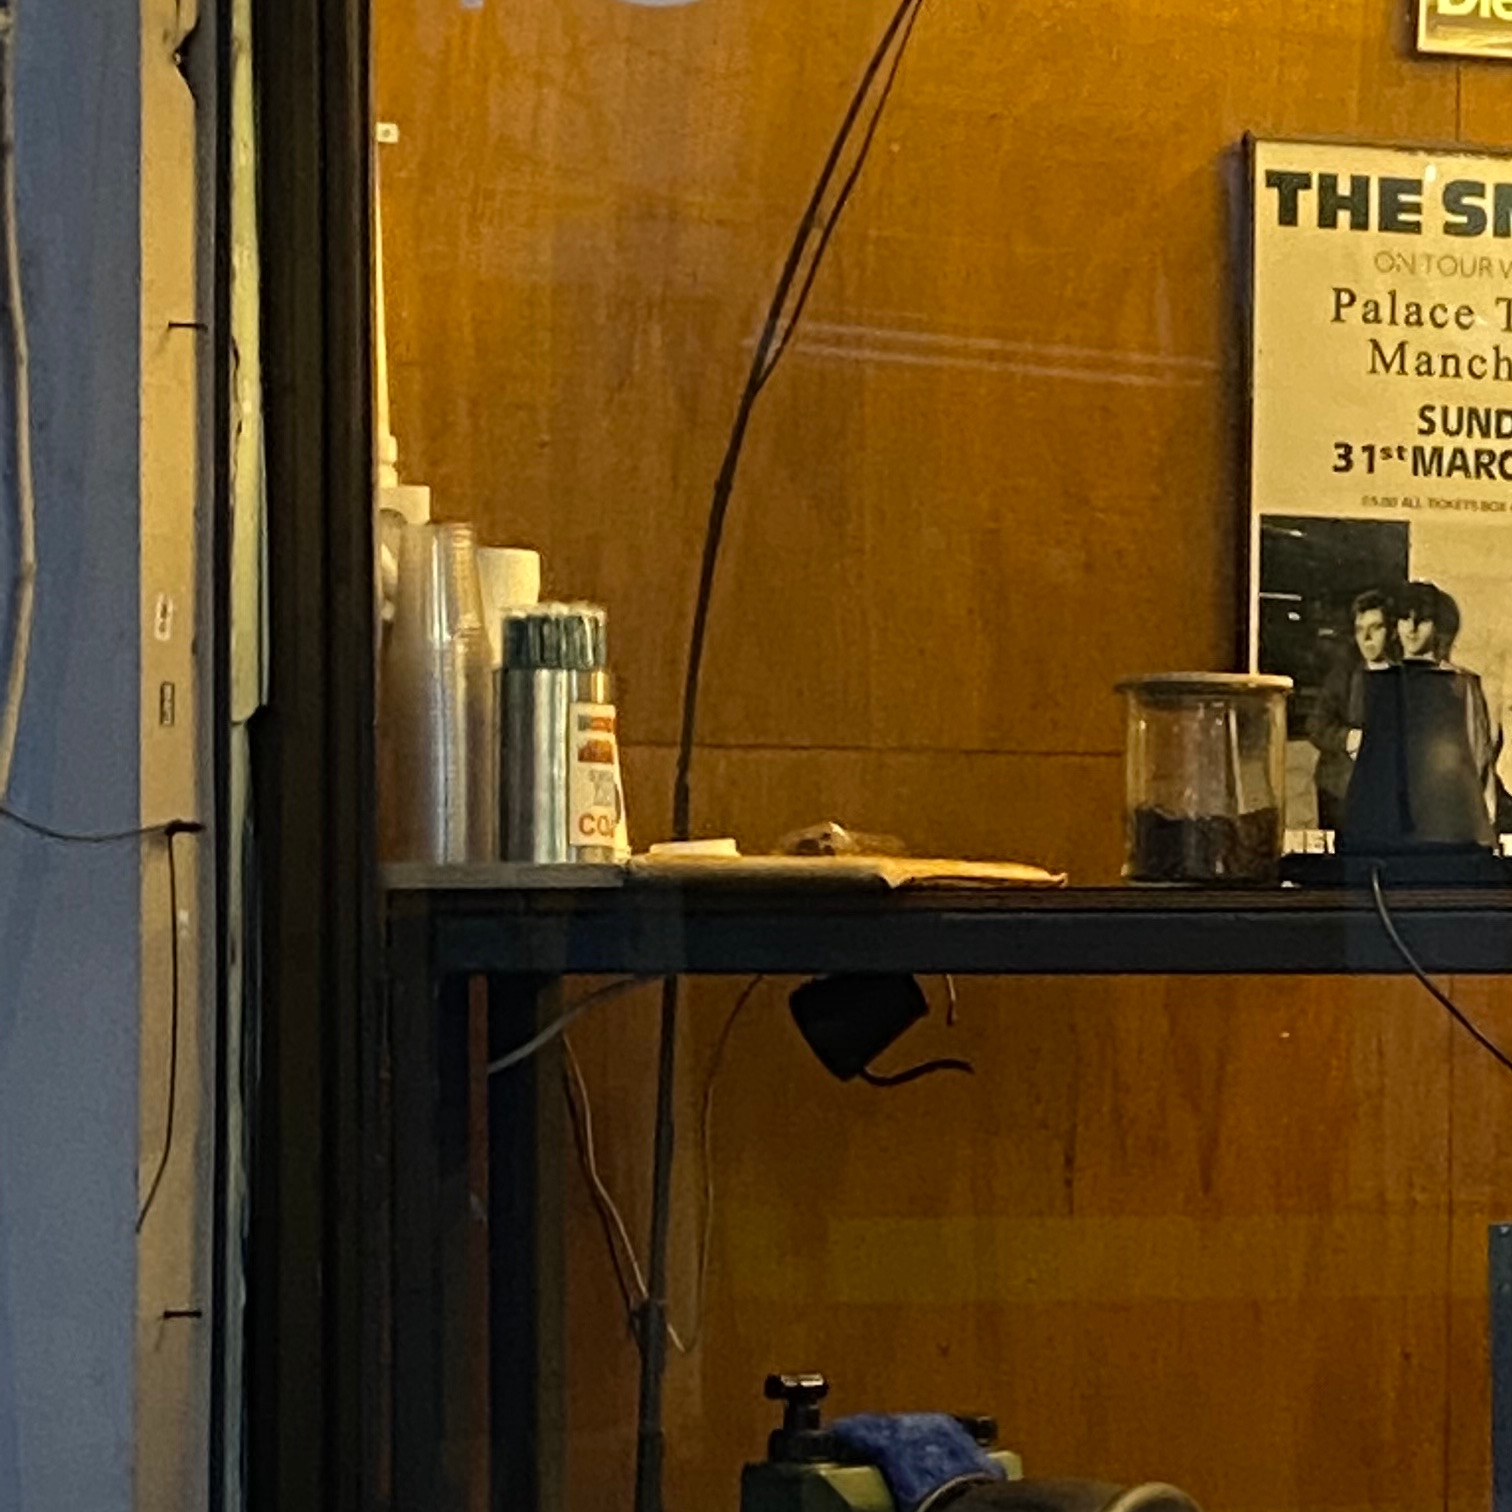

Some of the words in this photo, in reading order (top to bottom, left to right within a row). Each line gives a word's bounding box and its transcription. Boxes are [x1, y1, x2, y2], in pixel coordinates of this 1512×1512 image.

[1265, 169, 1423, 235] THE
[1374, 251, 1416, 274] ON
[1423, 254, 1492, 278] TOUR
[1331, 287, 1475, 329] Palace
[1332, 442, 1406, 474] 31st
